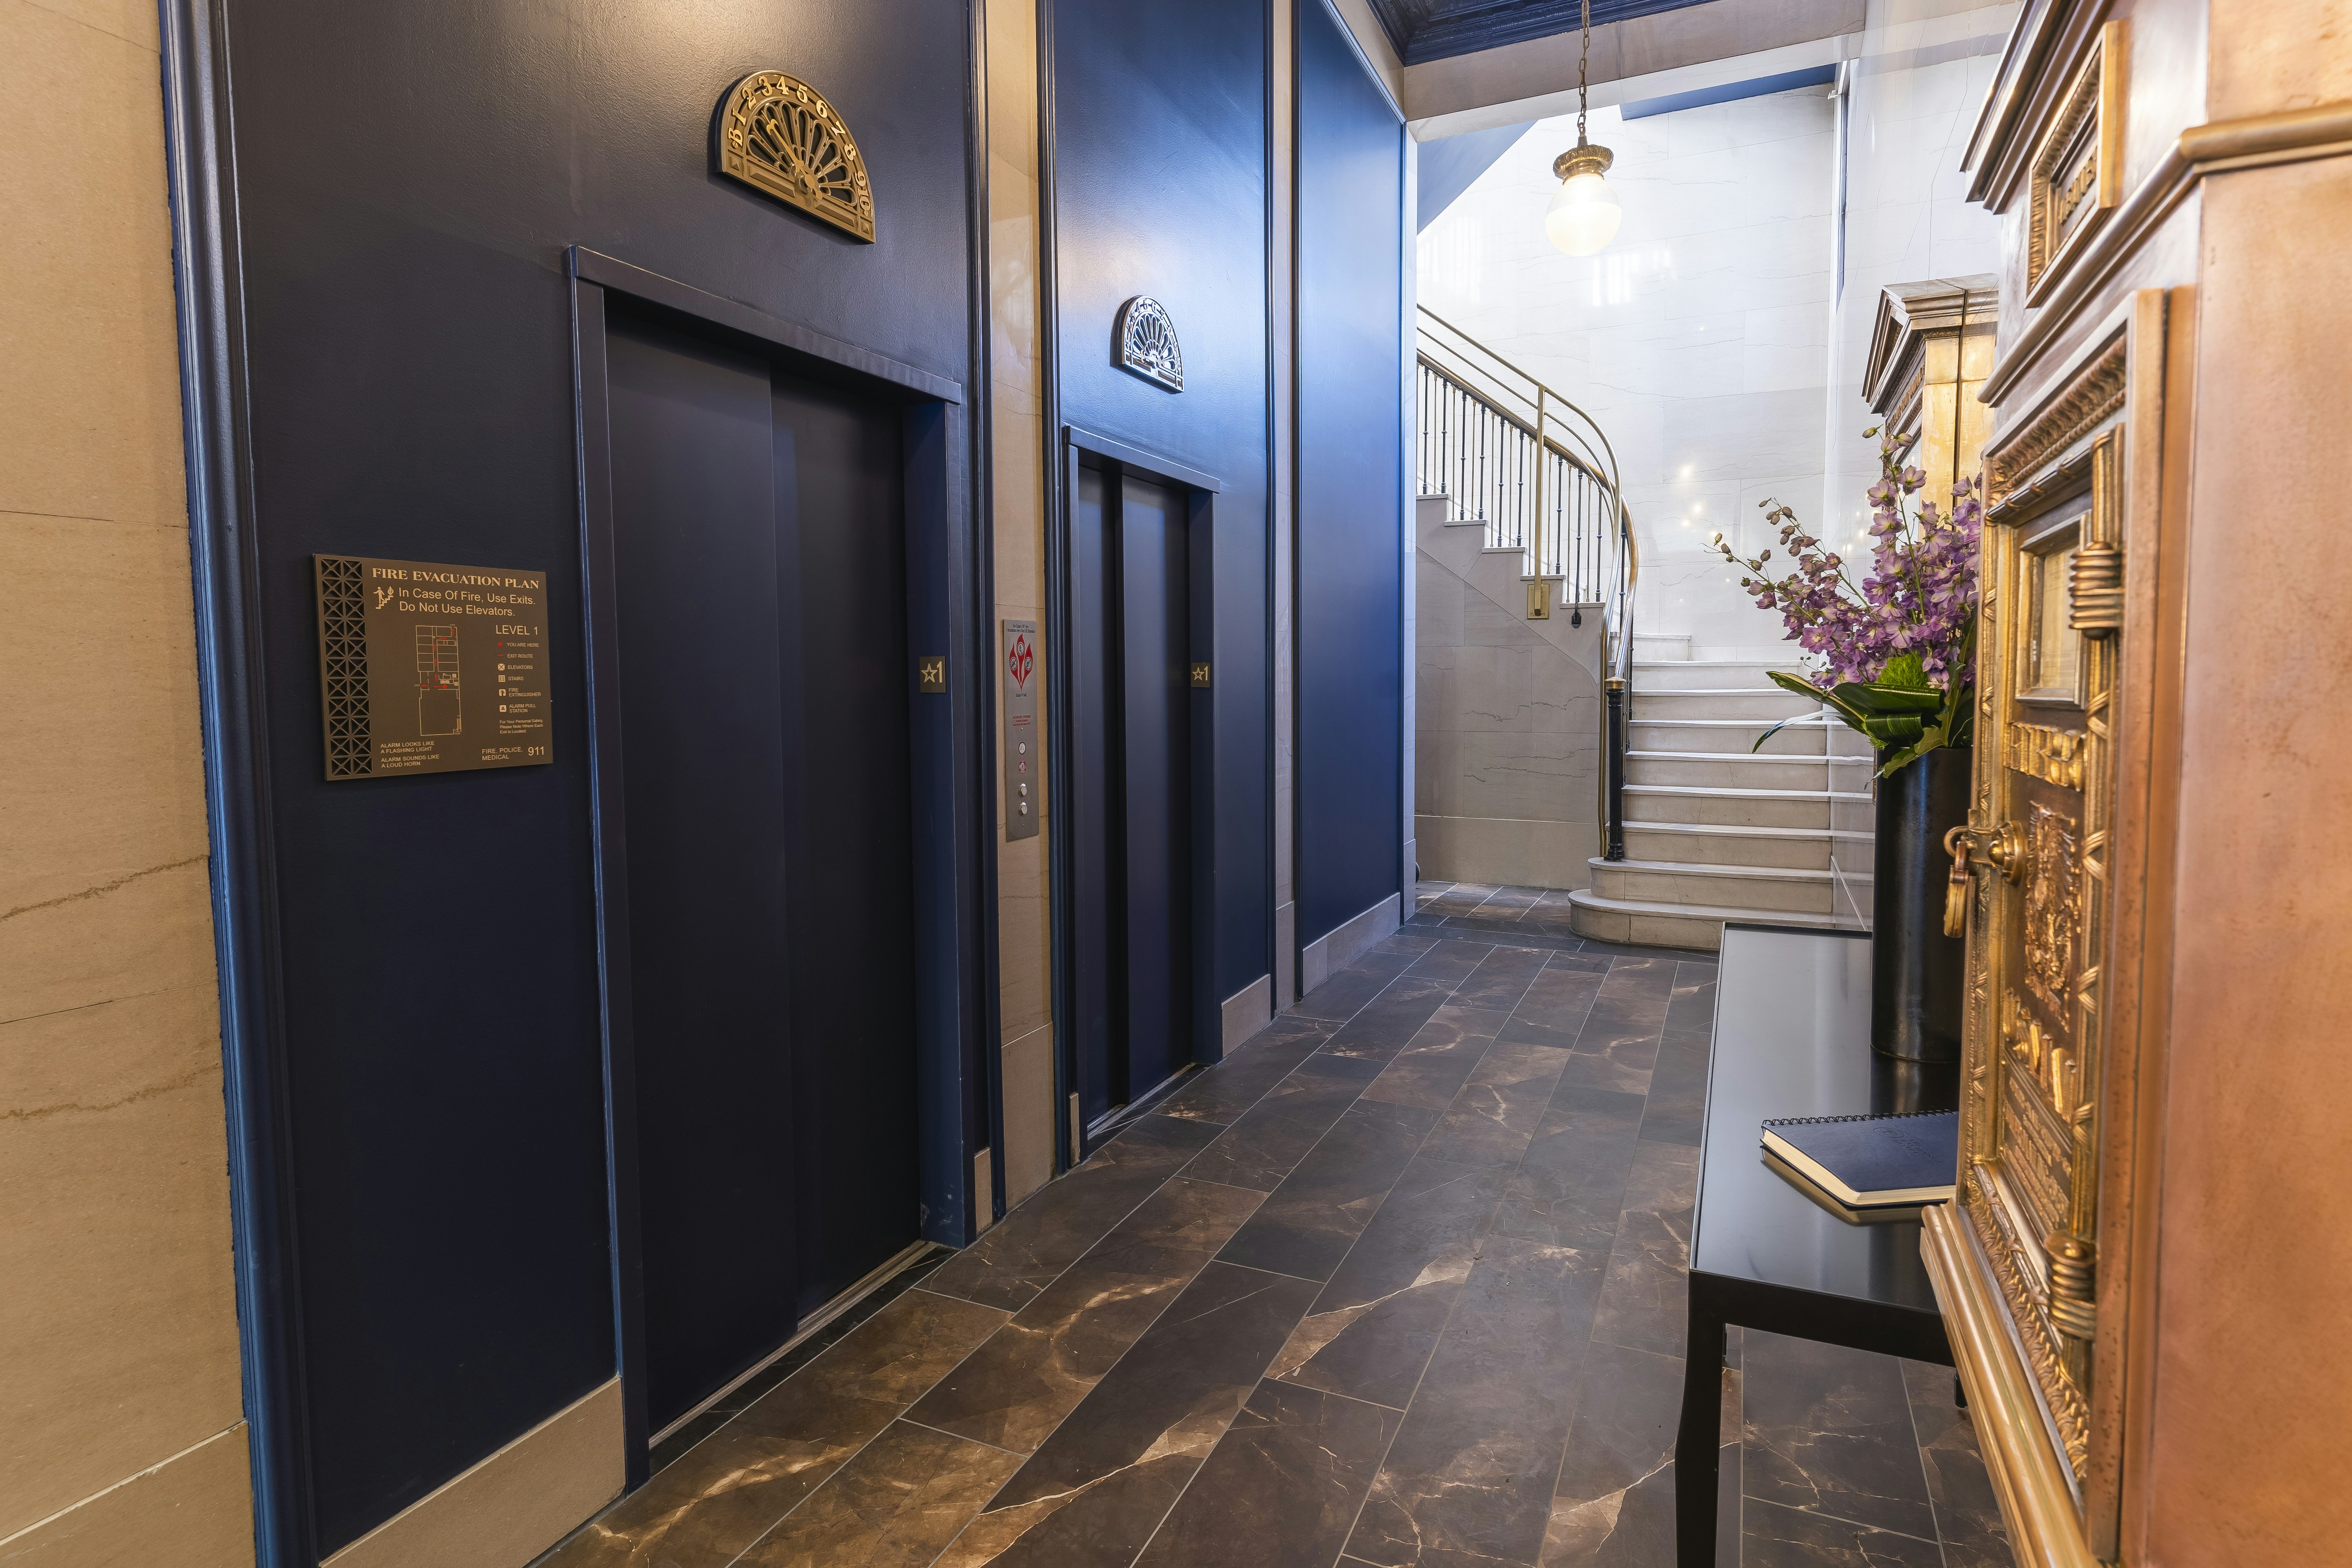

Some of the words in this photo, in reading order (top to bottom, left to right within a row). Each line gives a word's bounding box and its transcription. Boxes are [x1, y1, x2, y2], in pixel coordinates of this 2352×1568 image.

[758, 76, 772, 96] 3
[777, 76, 789, 95] 4
[797, 84, 808, 103] 5
[742, 87, 757, 110] 2
[732, 107, 746, 126] 1
[816, 100, 828, 118] 6
[728, 127, 743, 146] B
[830, 121, 845, 136] 7
[844, 144, 856, 161] 8
[855, 171, 866, 186] 9
[858, 188, 870, 210] 10
[372, 568, 408, 580] FIRE
[413, 571, 501, 586] EVACUATION
[505, 578, 539, 589] PLAN
[399, 587, 409, 597] In
[413, 588, 442, 599] Case
[445, 590, 458, 600] Of
[461, 591, 484, 603] Fire,
[487, 593, 507, 603] Use
[510, 594, 536, 605] Exits.
[400, 601, 415, 611] Do
[419, 602, 438, 613] Not
[442, 603, 462, 613] Use
[466, 605, 515, 616] Elevators.
[496, 625, 530, 635] LEVEL
[534, 626, 538, 635] 1
[937, 661, 942, 683] 1
[1204, 666, 1208, 681] 1
[528, 746, 544, 756] 911
